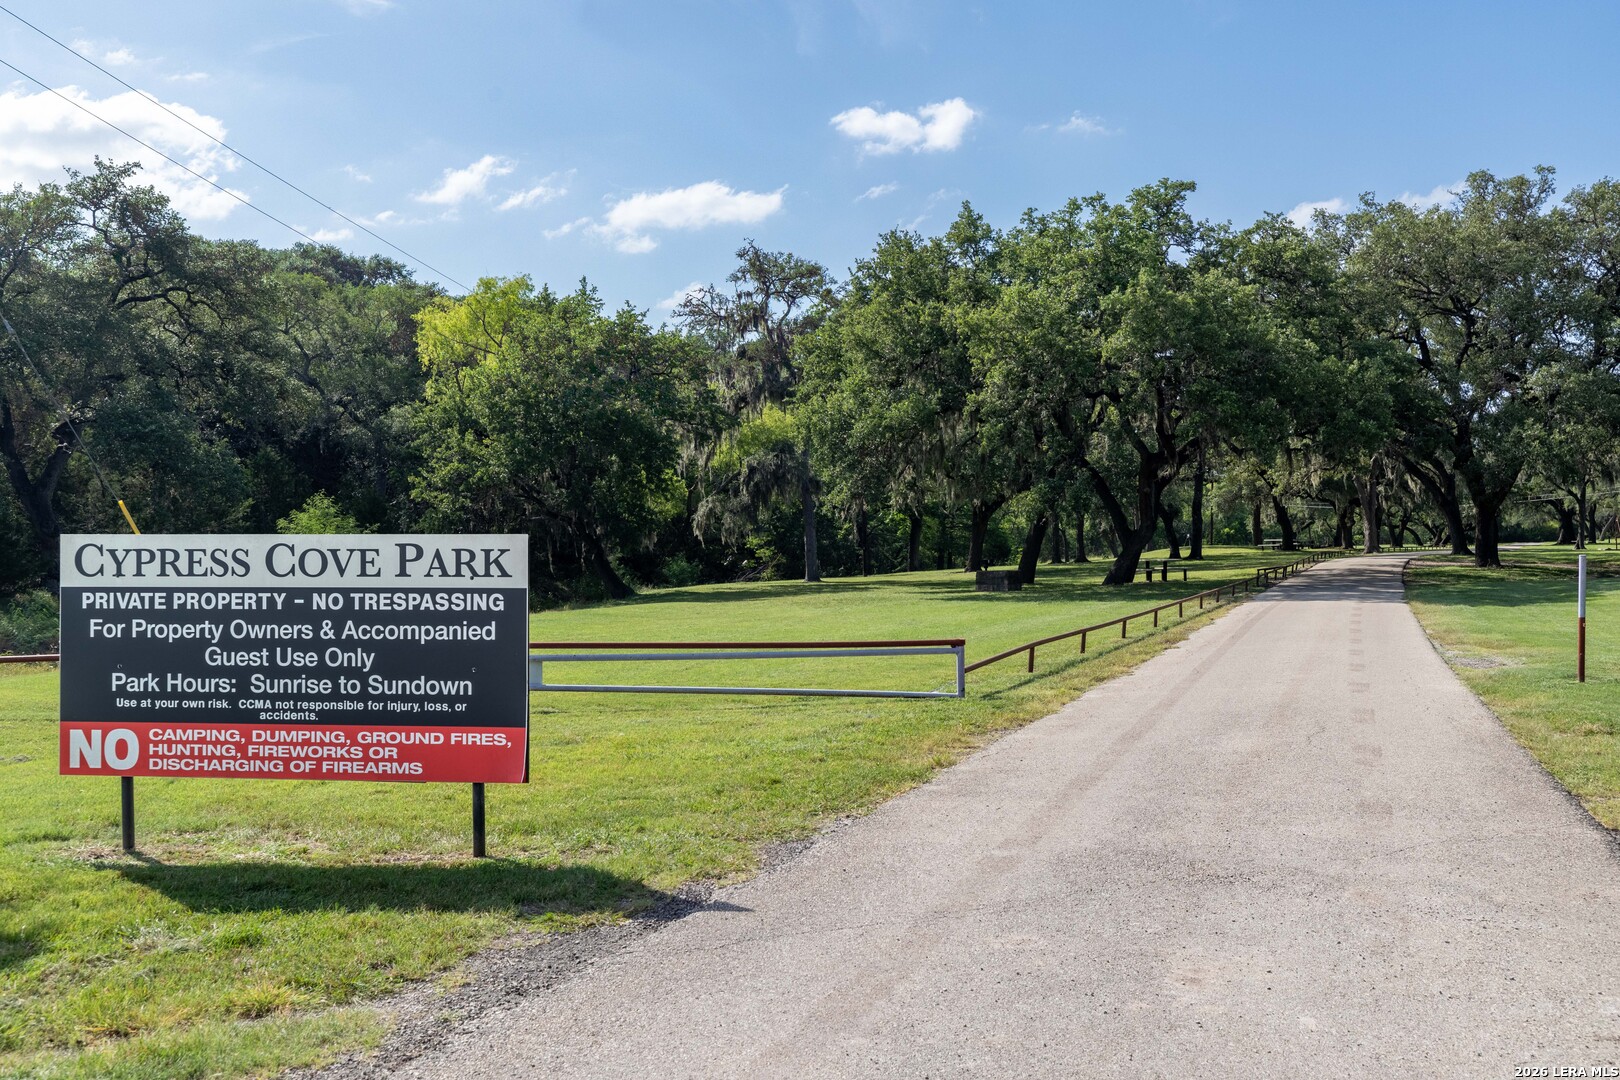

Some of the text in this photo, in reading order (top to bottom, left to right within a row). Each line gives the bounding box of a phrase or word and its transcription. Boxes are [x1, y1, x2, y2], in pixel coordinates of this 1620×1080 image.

[74, 543, 512, 577] CYPRESS COVE PARK
[81, 592, 166, 609] PRIVATE
[173, 592, 287, 610] PROPERTY
[312, 593, 344, 610] NO
[350, 593, 505, 611] TRESPASSING
[89, 619, 496, 644] For Property Owners & Accompanied
[204, 646, 375, 672] Guest Use Only
[111, 673, 473, 695] Park Hours: Sunrise to Sundown
[116, 698, 467, 712] Use at your own risk. CCMA not responsible for injury, loss, or
[259, 711, 319, 721] accidents.
[149, 728, 512, 748] CAMPING, DUMPING, GROUND FIRES,
[69, 728, 140, 770] NO
[149, 744, 398, 759] HUNTING, FIREWORKS OR
[149, 758, 423, 774] DISCHARGING OF FIREARMS
